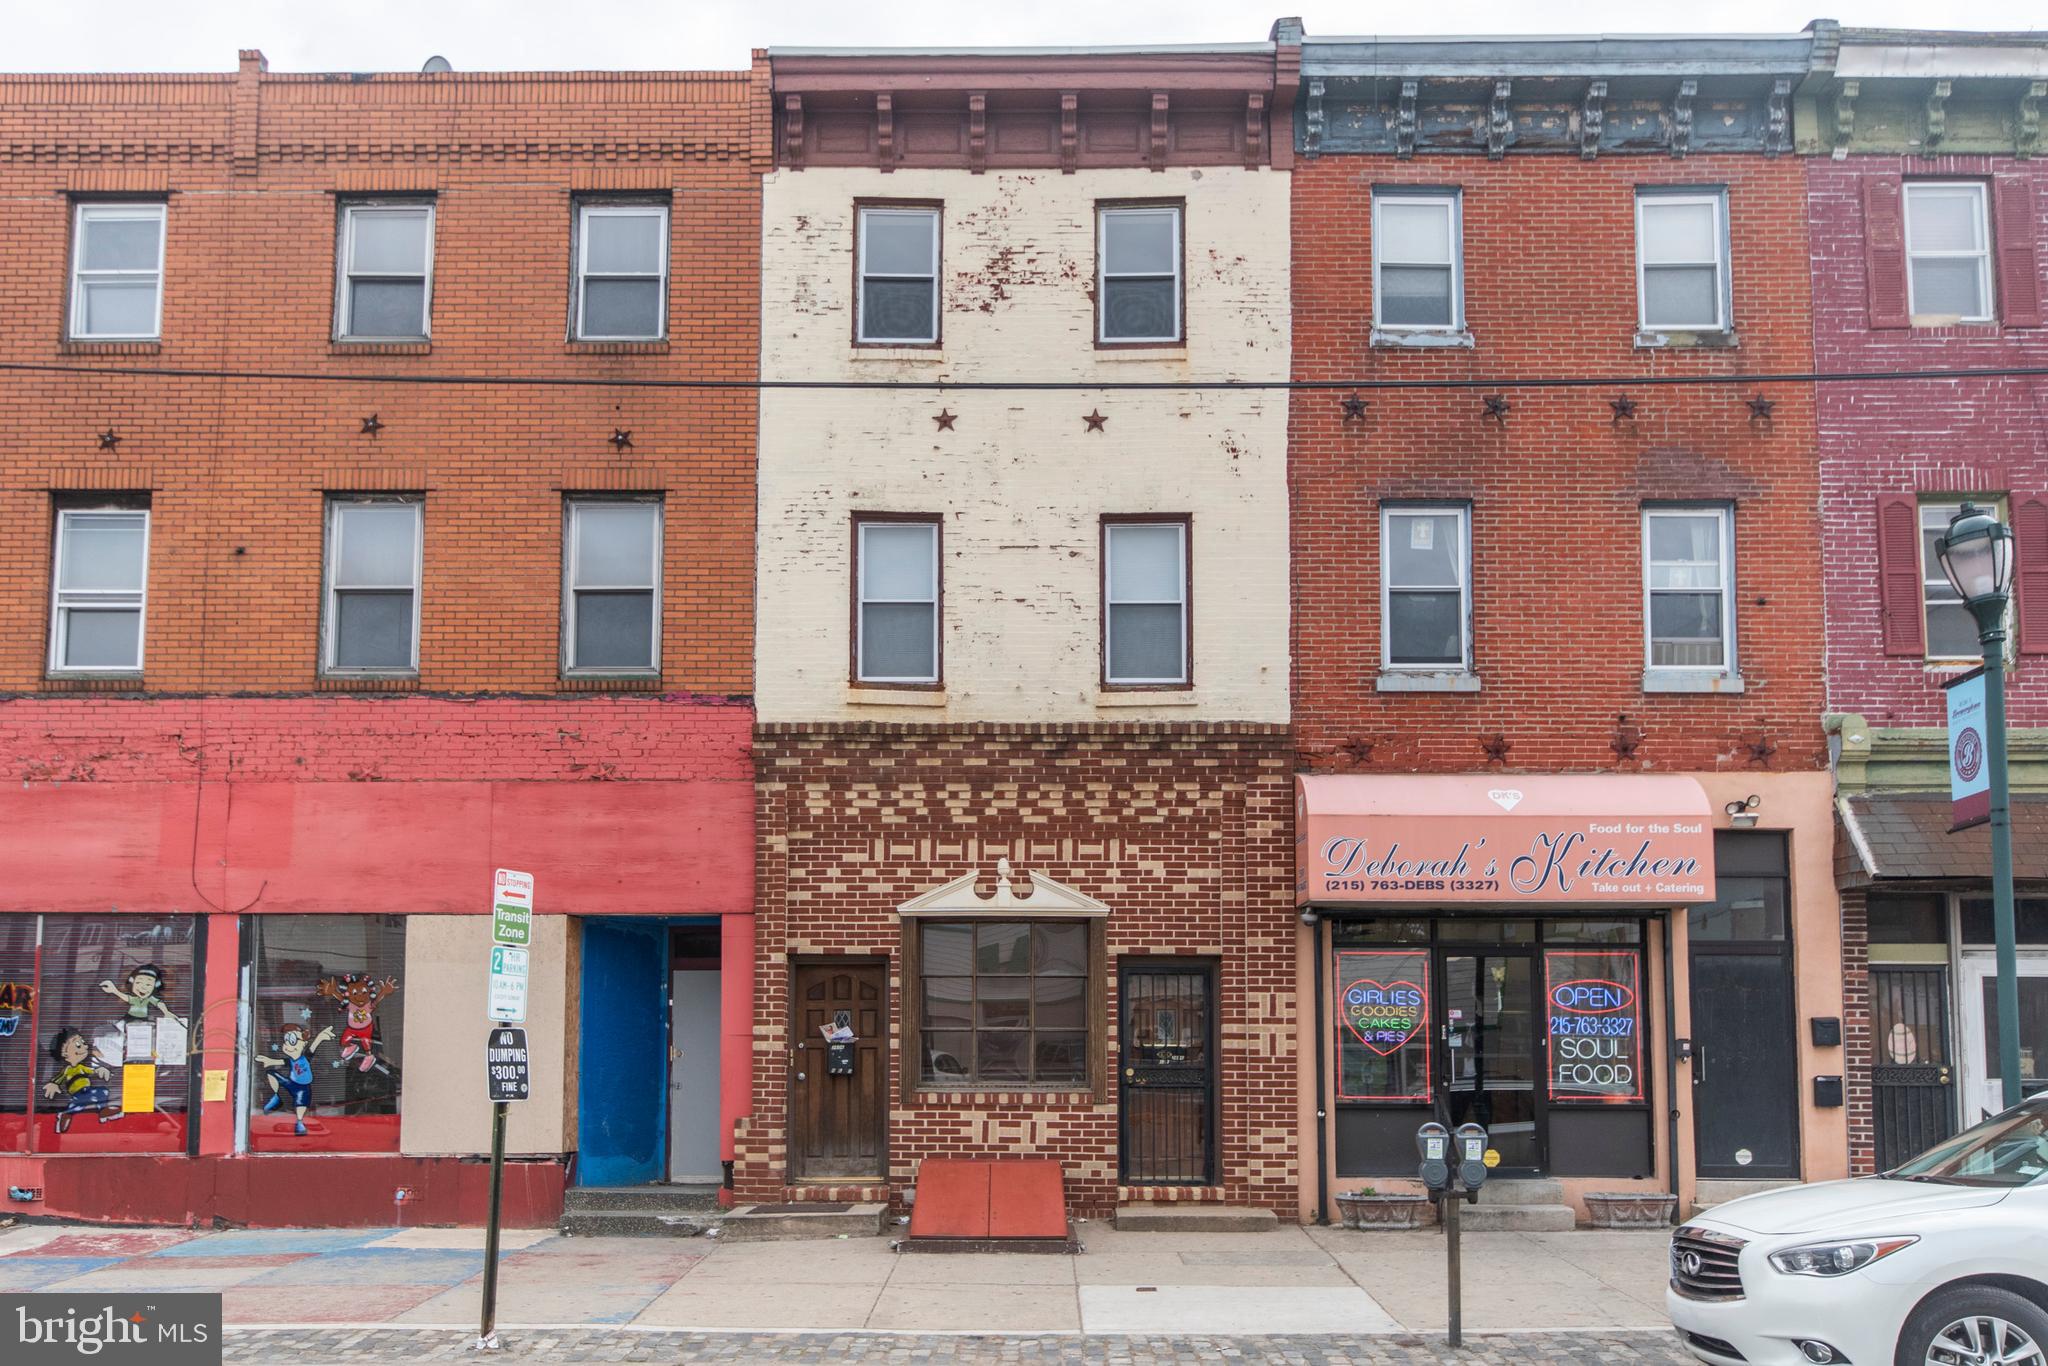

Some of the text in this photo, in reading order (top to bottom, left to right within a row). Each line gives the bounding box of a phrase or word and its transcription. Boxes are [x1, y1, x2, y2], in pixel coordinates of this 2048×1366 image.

[1492, 791, 1521, 801] DK'S
[1589, 823, 1702, 834] Food for the Soul
[1320, 831, 1701, 895] Deborah's Kitchen
[1326, 880, 1500, 892] (215) 763-DEBS (3327)
[1591, 882, 1618, 893] Take
[1622, 883, 1641, 893] out
[1655, 882, 1705, 895] Catering
[496, 908, 530, 924] Transit
[498, 924, 525, 939] Zone
[493, 951, 502, 971] 2
[1348, 989, 1421, 1006] GIRLIES
[1556, 986, 1621, 1007] OPEN
[1350, 1005, 1418, 1017] GOODIES
[1358, 1017, 1412, 1029] CAKES
[1550, 1016, 1633, 1036] 215-763-3327
[500, 1031, 513, 1045] NO
[1364, 1030, 1407, 1042] & PIES
[489, 1048, 526, 1062] DUMPING
[1560, 1038, 1629, 1059] SOUL
[1558, 1064, 1633, 1085] FOOD
[501, 1082, 518, 1092] FINE
